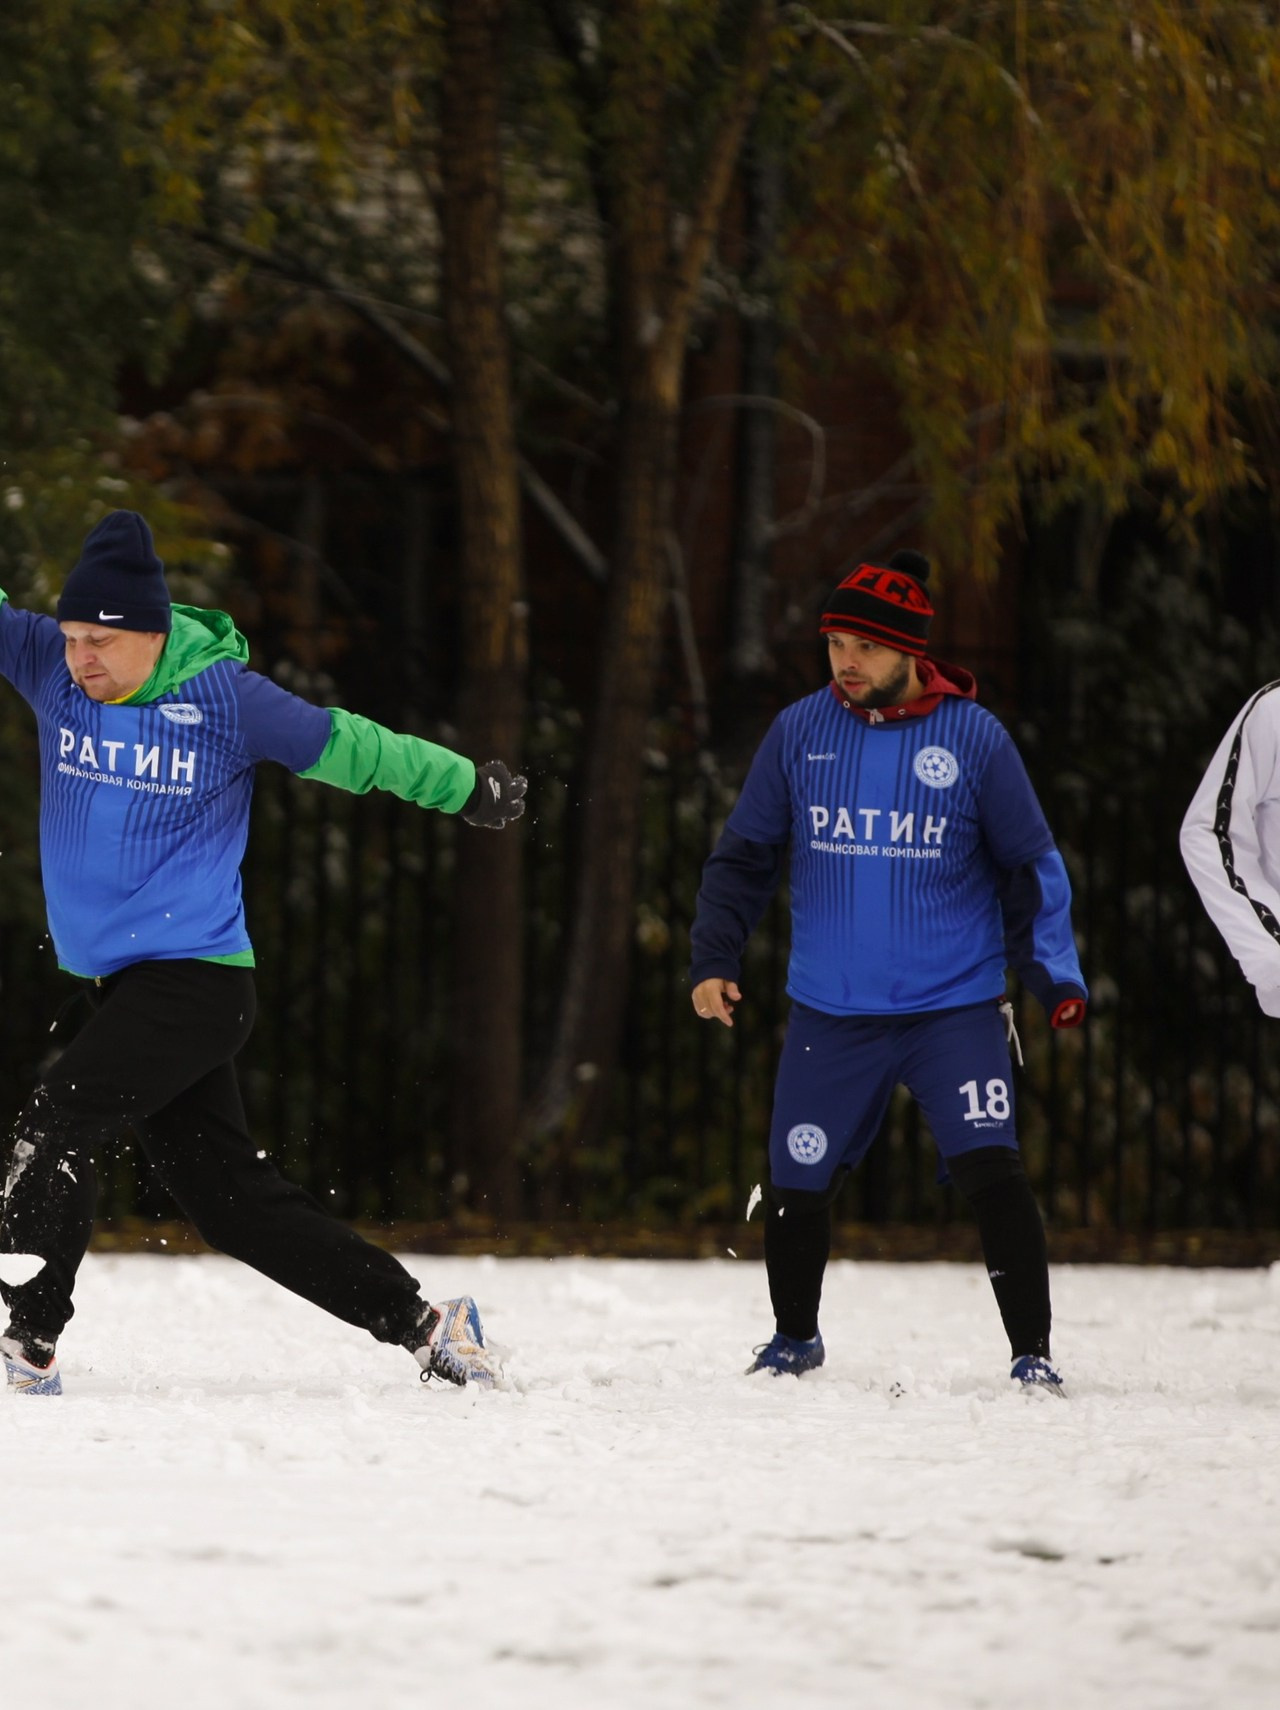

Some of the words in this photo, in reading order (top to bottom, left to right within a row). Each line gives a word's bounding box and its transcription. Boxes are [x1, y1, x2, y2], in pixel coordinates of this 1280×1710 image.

[59, 727, 196, 783] РАТИН
[57, 762, 123, 786] ФИНАНСОВАЯ
[126, 780, 193, 797] КОМПАНИЯ
[809, 805, 947, 845] РАТИН
[810, 839, 879, 857] ФИНАНСОВАЯ
[881, 846, 942, 860] КОМПАНИЯ
[958, 1078, 1011, 1121] 18
